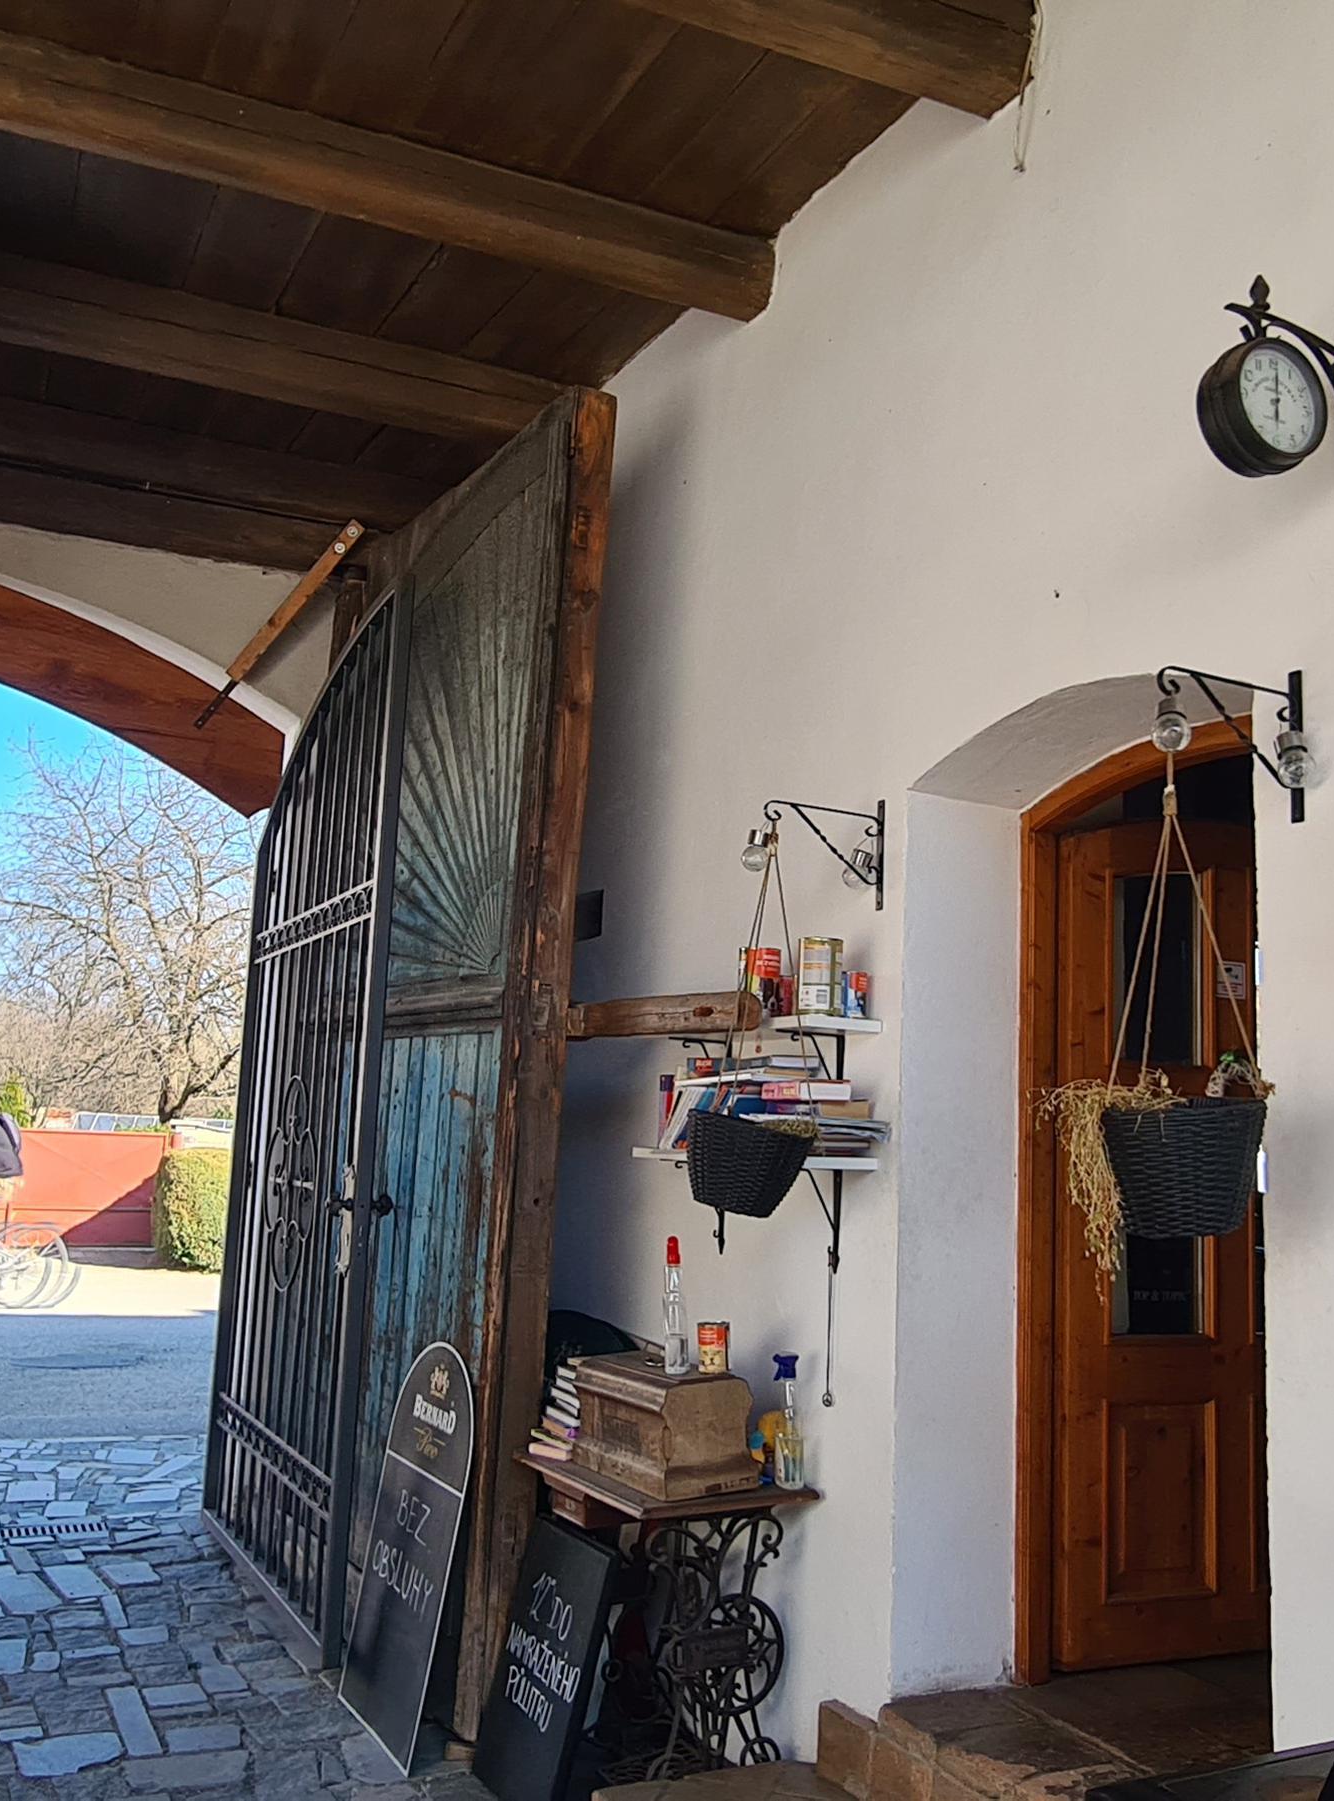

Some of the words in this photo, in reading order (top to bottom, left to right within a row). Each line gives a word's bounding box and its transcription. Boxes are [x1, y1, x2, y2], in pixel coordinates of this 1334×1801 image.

[413, 1393, 457, 1435] BERNARD
[397, 1489, 430, 1547] BEZ
[372, 1539, 433, 1622] OBSLUHY
[546, 1596, 573, 1641] DO
[505, 1621, 581, 1704] NAMRAŽENÉHO
